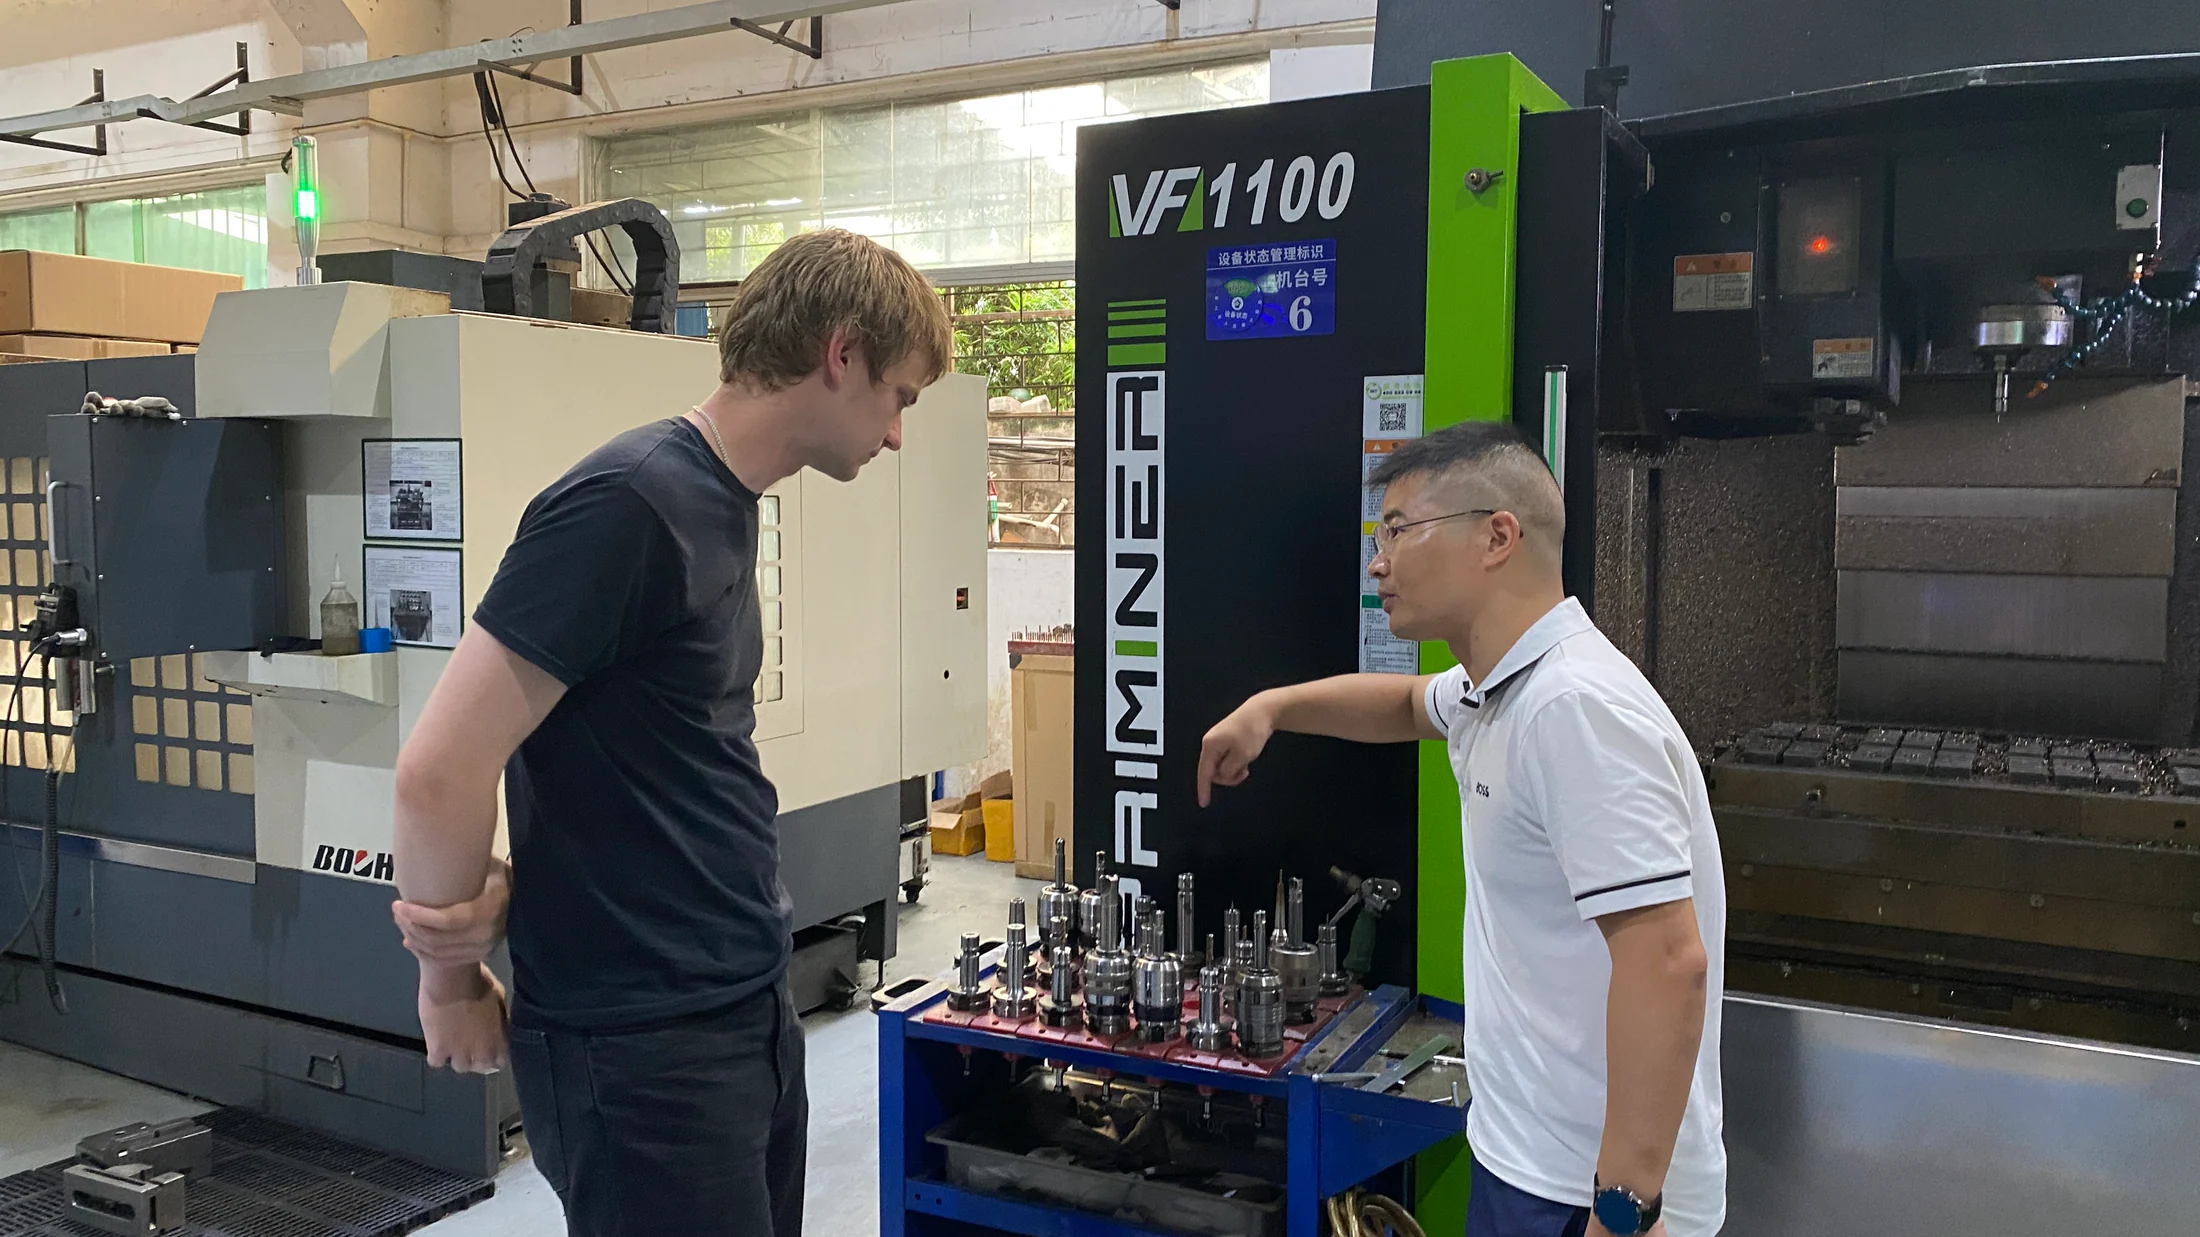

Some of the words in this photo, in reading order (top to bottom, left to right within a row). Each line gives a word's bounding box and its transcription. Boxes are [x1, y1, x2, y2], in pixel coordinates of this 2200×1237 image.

[1112, 166, 1202, 237] VF
[1209, 151, 1355, 229] 1100
[1218, 244, 1324, 267] 设备状态管理标识
[1275, 267, 1328, 290] 机台号
[1289, 295, 1313, 332] 6
